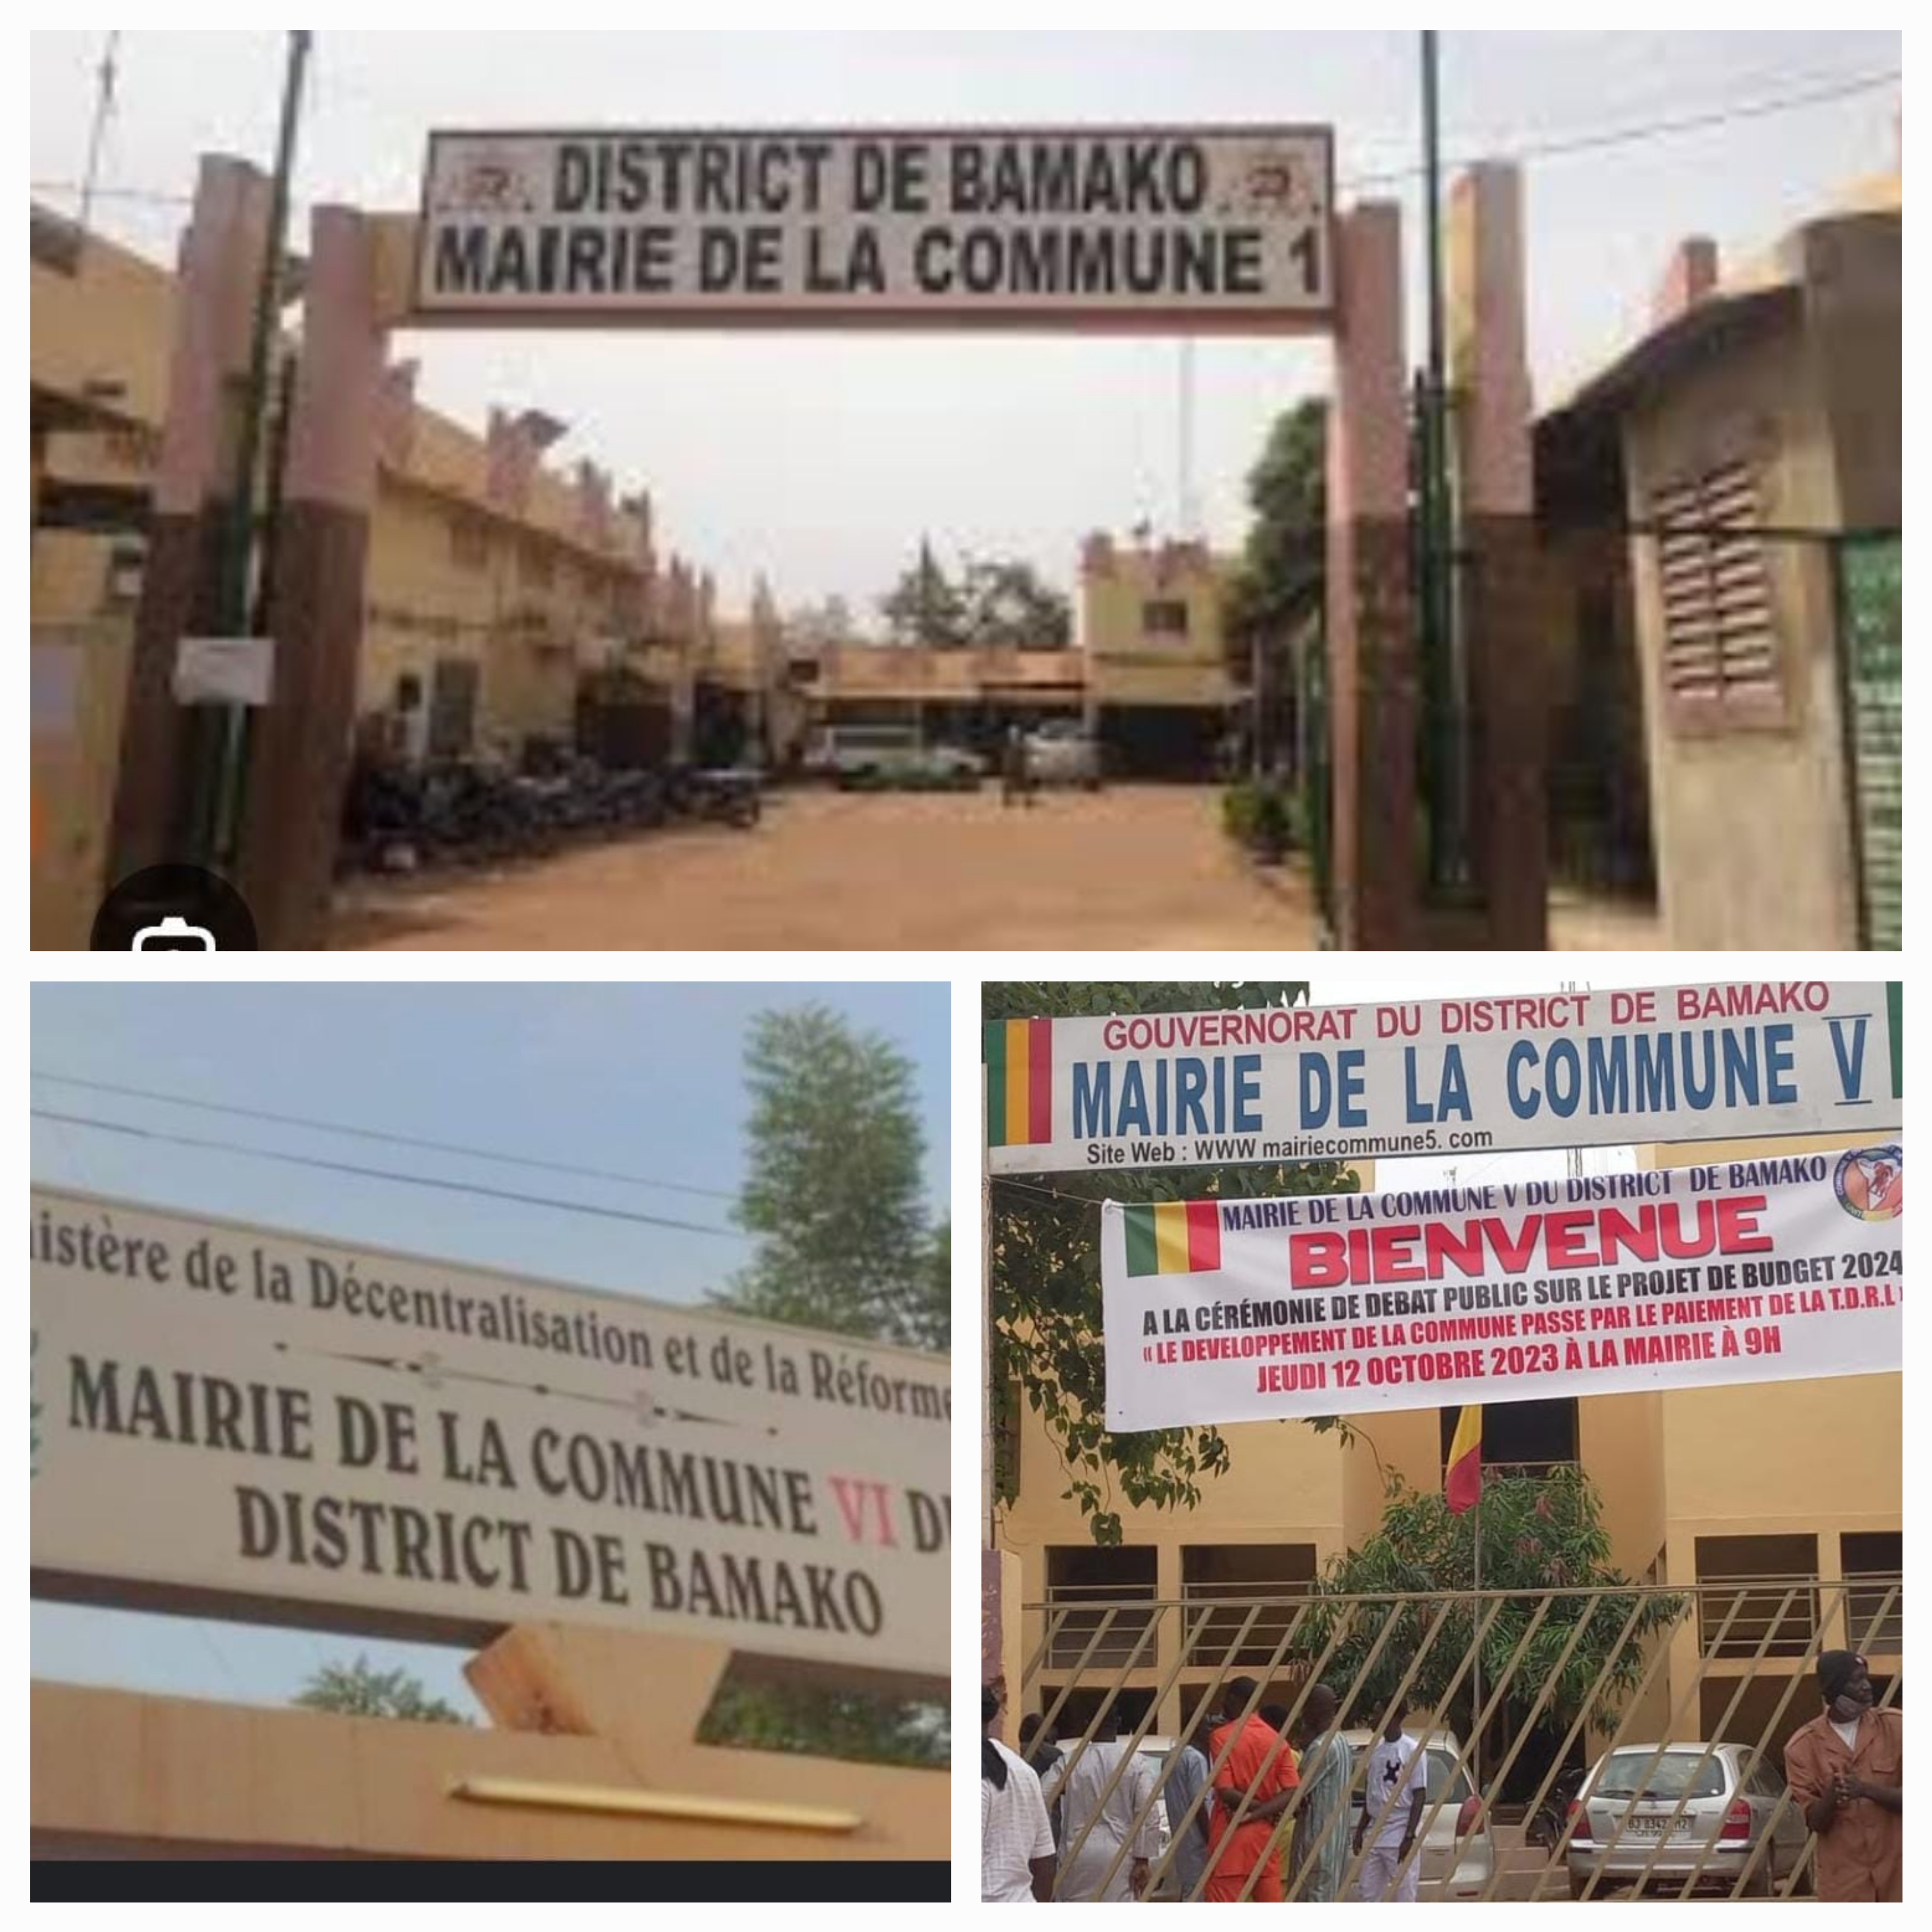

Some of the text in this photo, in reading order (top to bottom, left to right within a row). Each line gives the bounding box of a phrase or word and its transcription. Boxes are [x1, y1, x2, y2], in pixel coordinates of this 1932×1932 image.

[553, 142, 1205, 212] DISTRICT DE BAMAKO
[435, 227, 1320, 294] MAIRIE DE LA COMMUNE 1
[1104, 980, 1829, 1051] GOUVERNORAT DU DISTRICT DE BAMAKO
[1073, 1014, 1872, 1139] MAIRIE DE LA COMMUNE V
[1087, 1129, 1493, 1165] Site Web : WWW mairiecommune5. com
[1224, 1155, 1827, 1232] MAIRIE DE LA COMMUNE V DU DISTRICT DE BAMAKO
[1289, 1195, 1774, 1291] BIENVENUE
[30, 1210, 171, 1284] istère
[185, 1238, 237, 1296] de
[252, 1248, 294, 1304] la
[307, 1257, 655, 1369] Décentralisation
[664, 1334, 700, 1379] et
[709, 1334, 753, 1388] de
[764, 1344, 800, 1396] la
[1142, 1250, 1902, 1336] A LA CÉRÉMONIE DE DEBAT PUBLIC SUR LE PROJET DE BUDGET 2024
[1157, 1341, 1177, 1364] LE
[1182, 1328, 1347, 1362] DEVELOPPEMENT
[1352, 1326, 1378, 1350] DE
[1381, 1324, 1406, 1347] LA
[1410, 1315, 1516, 1343] COMMUNE
[1521, 1309, 1586, 1336] PASSE
[1590, 1305, 1631, 1330] PAR
[1635, 1304, 1657, 1327] LE
[1662, 1295, 1764, 1326] PAIEMENT
[1768, 1292, 1796, 1316] DE
[1799, 1289, 1826, 1313] LA
[1256, 1325, 1782, 1393] JEUDI 12 OCTOBRE 2023 À LA MAIRIE À 9H
[66, 1353, 315, 1462] MAIRIE
[333, 1395, 420, 1476] DE
[438, 1409, 517, 1489] LA
[531, 1426, 818, 1537] COMMUNE
[826, 1473, 900, 1548] VI
[234, 1484, 884, 1638] DISTRICT DE BAMAKO
